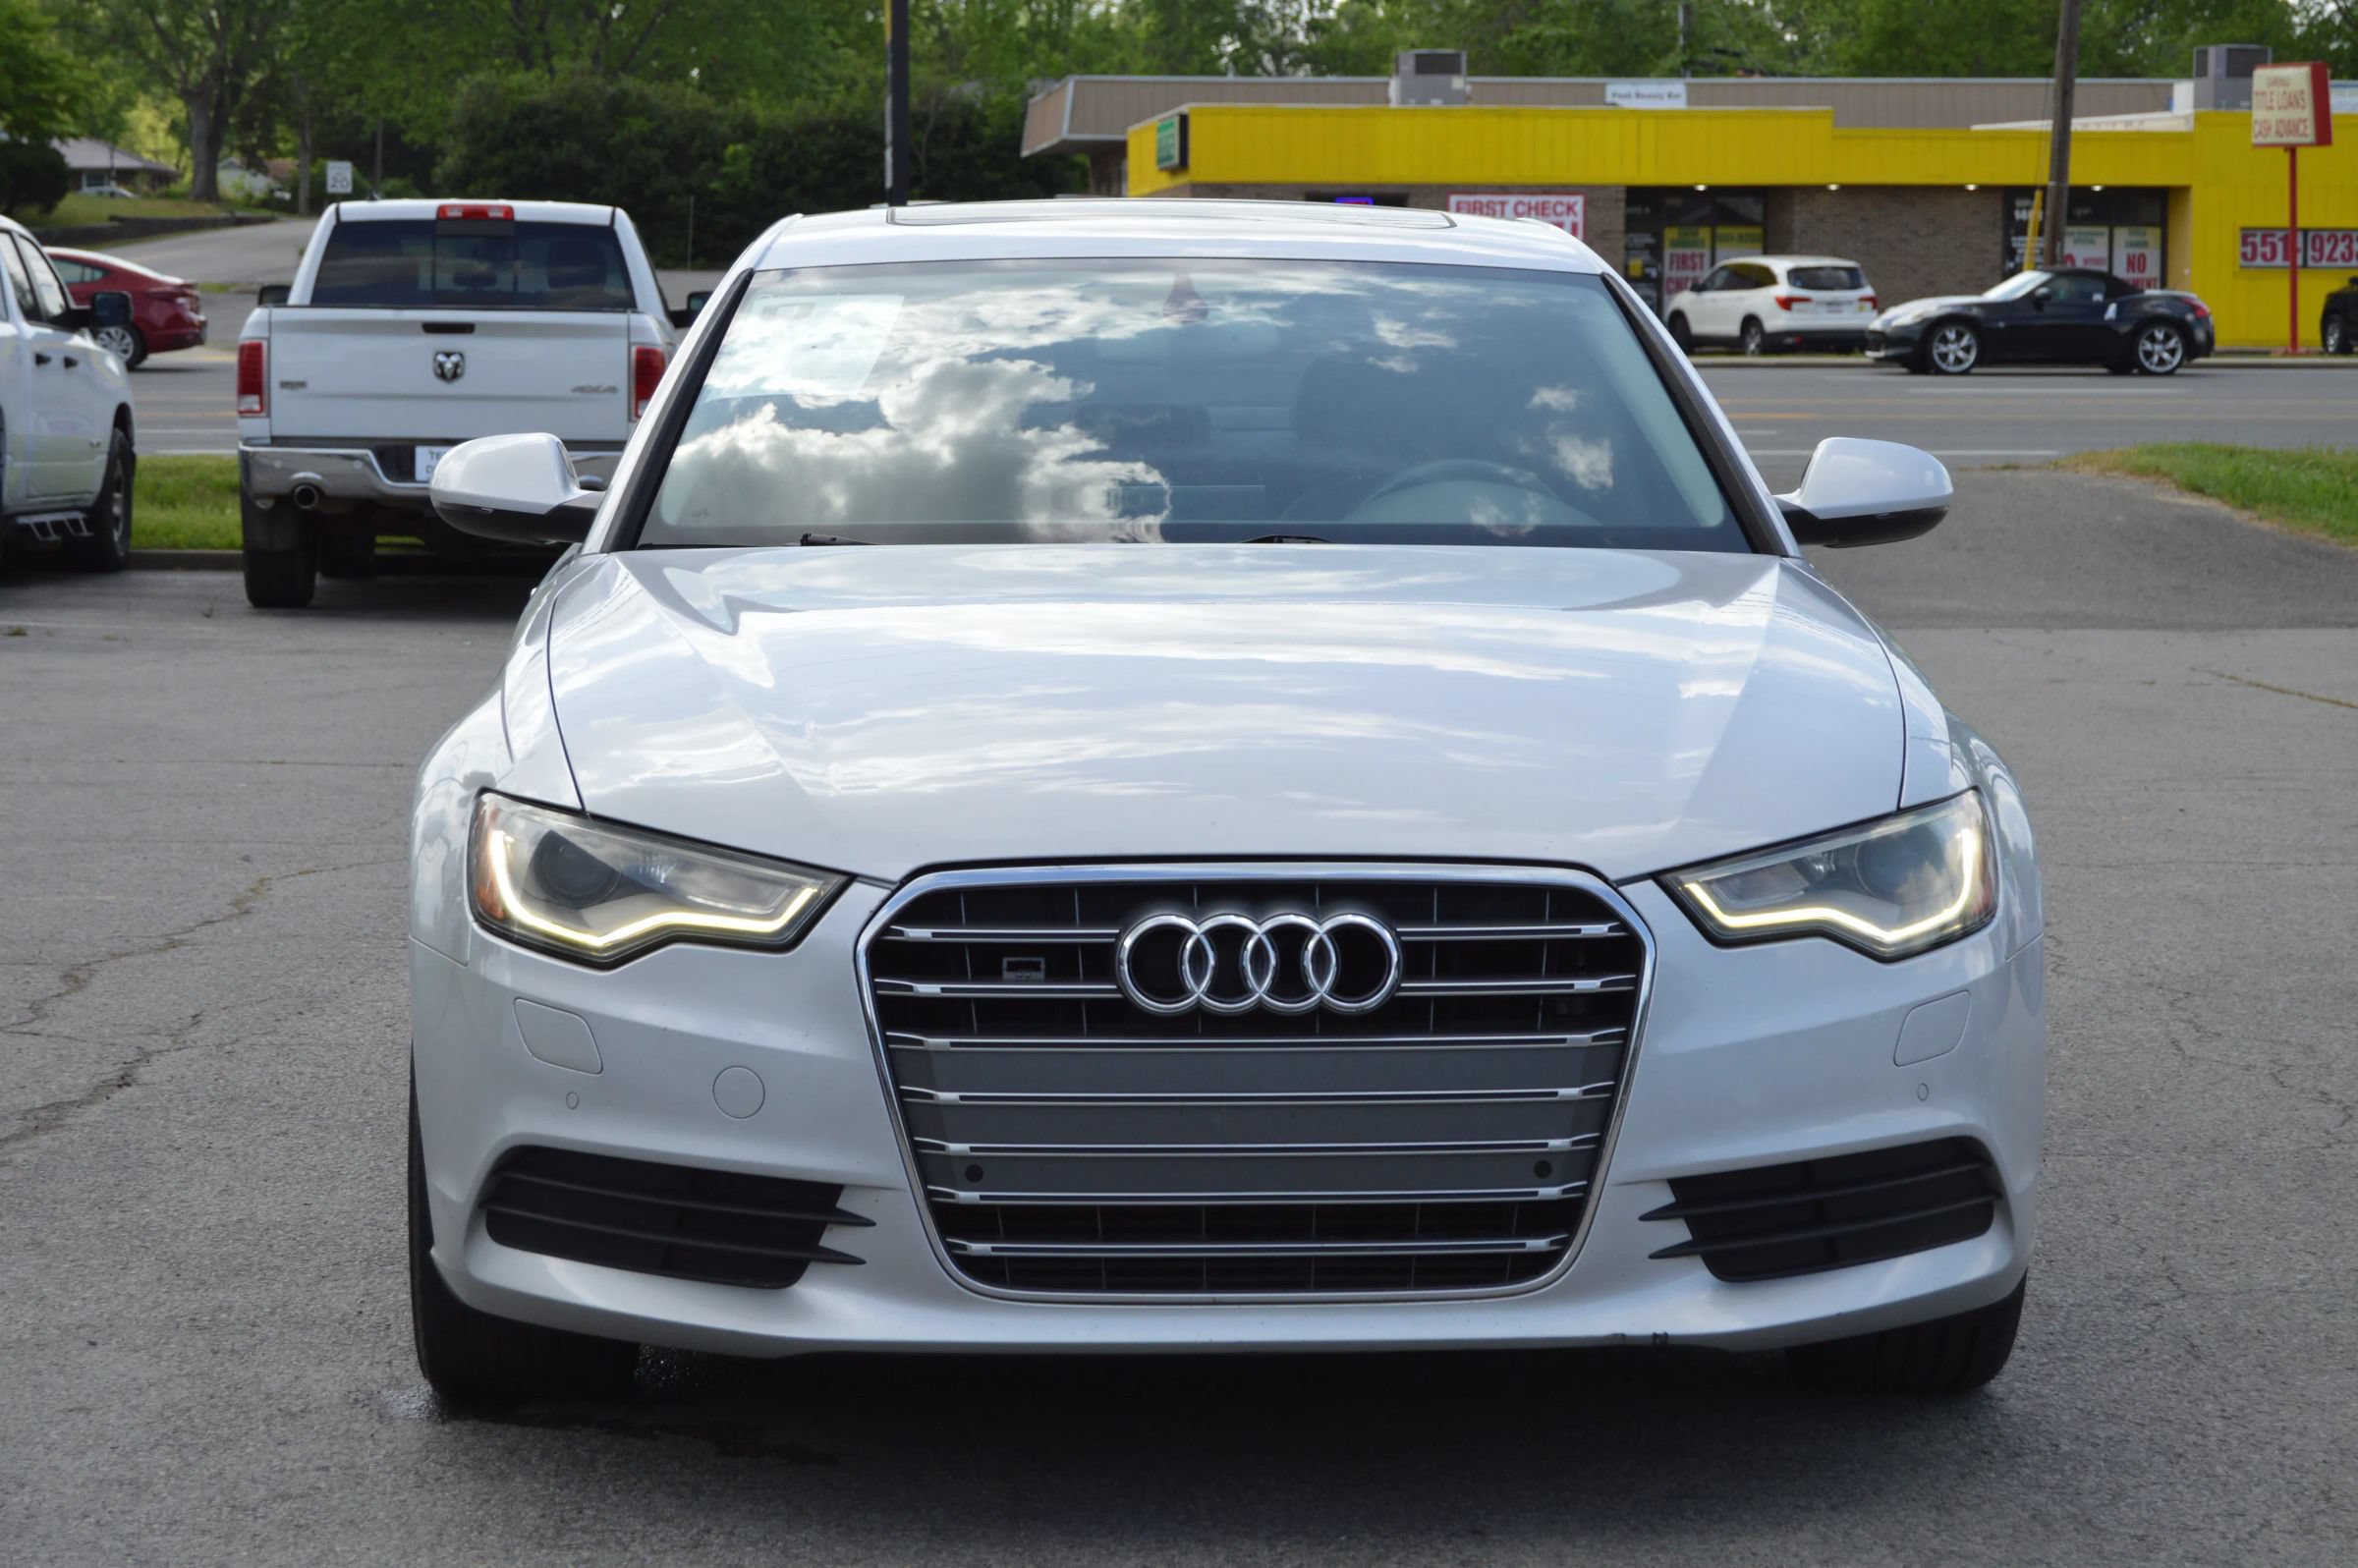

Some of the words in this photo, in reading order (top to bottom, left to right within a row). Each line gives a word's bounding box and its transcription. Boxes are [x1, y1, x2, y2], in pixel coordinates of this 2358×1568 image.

[2277, 89, 2306, 110] LOANS
[2254, 119, 2273, 138] CASH
[2274, 118, 2309, 138] ADVANCE
[1456, 200, 1509, 217] FIRST
[1513, 199, 1578, 217] CHECK
[2310, 232, 2358, 263] 923
[1669, 252, 1706, 271] FIRST
[2126, 252, 2147, 273] NO
